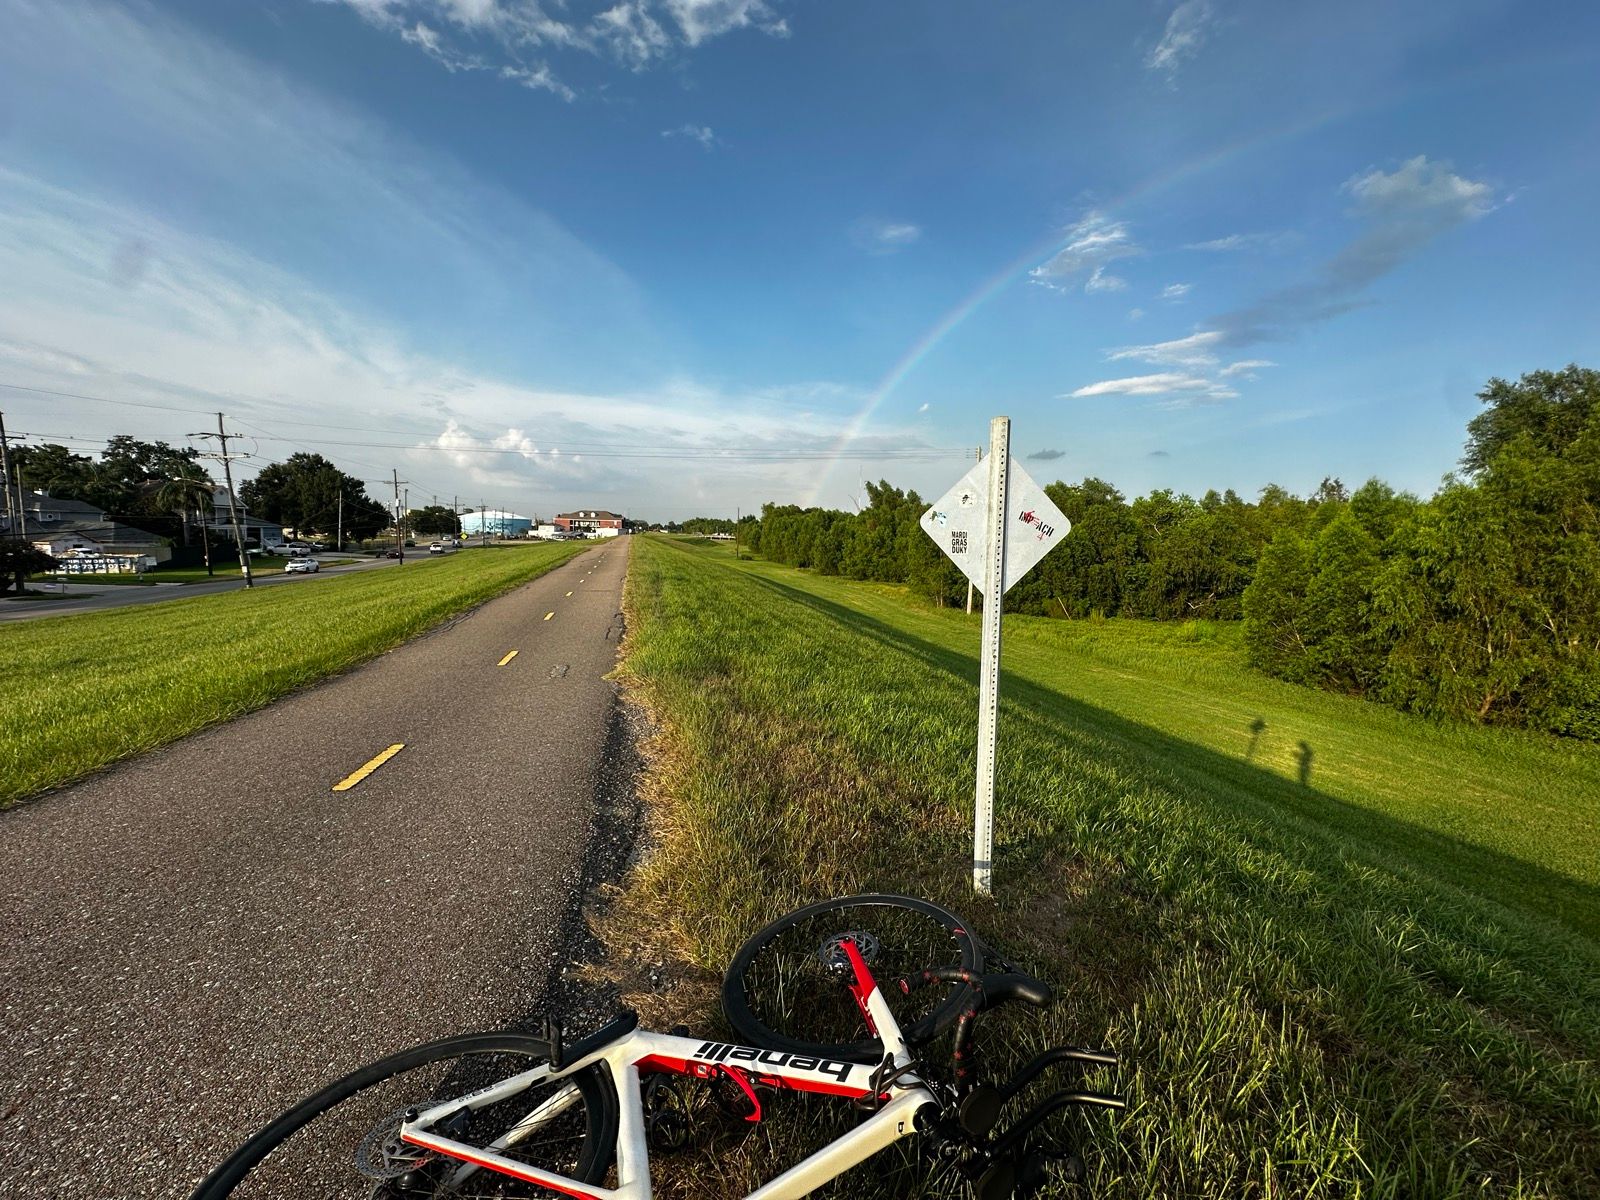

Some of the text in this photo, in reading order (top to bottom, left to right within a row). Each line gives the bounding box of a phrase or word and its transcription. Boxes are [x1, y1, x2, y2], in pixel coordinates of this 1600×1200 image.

[951, 531, 967, 539] MARDI
[951, 539, 967, 547] GRAS
[693, 1042, 854, 1083] benelli
